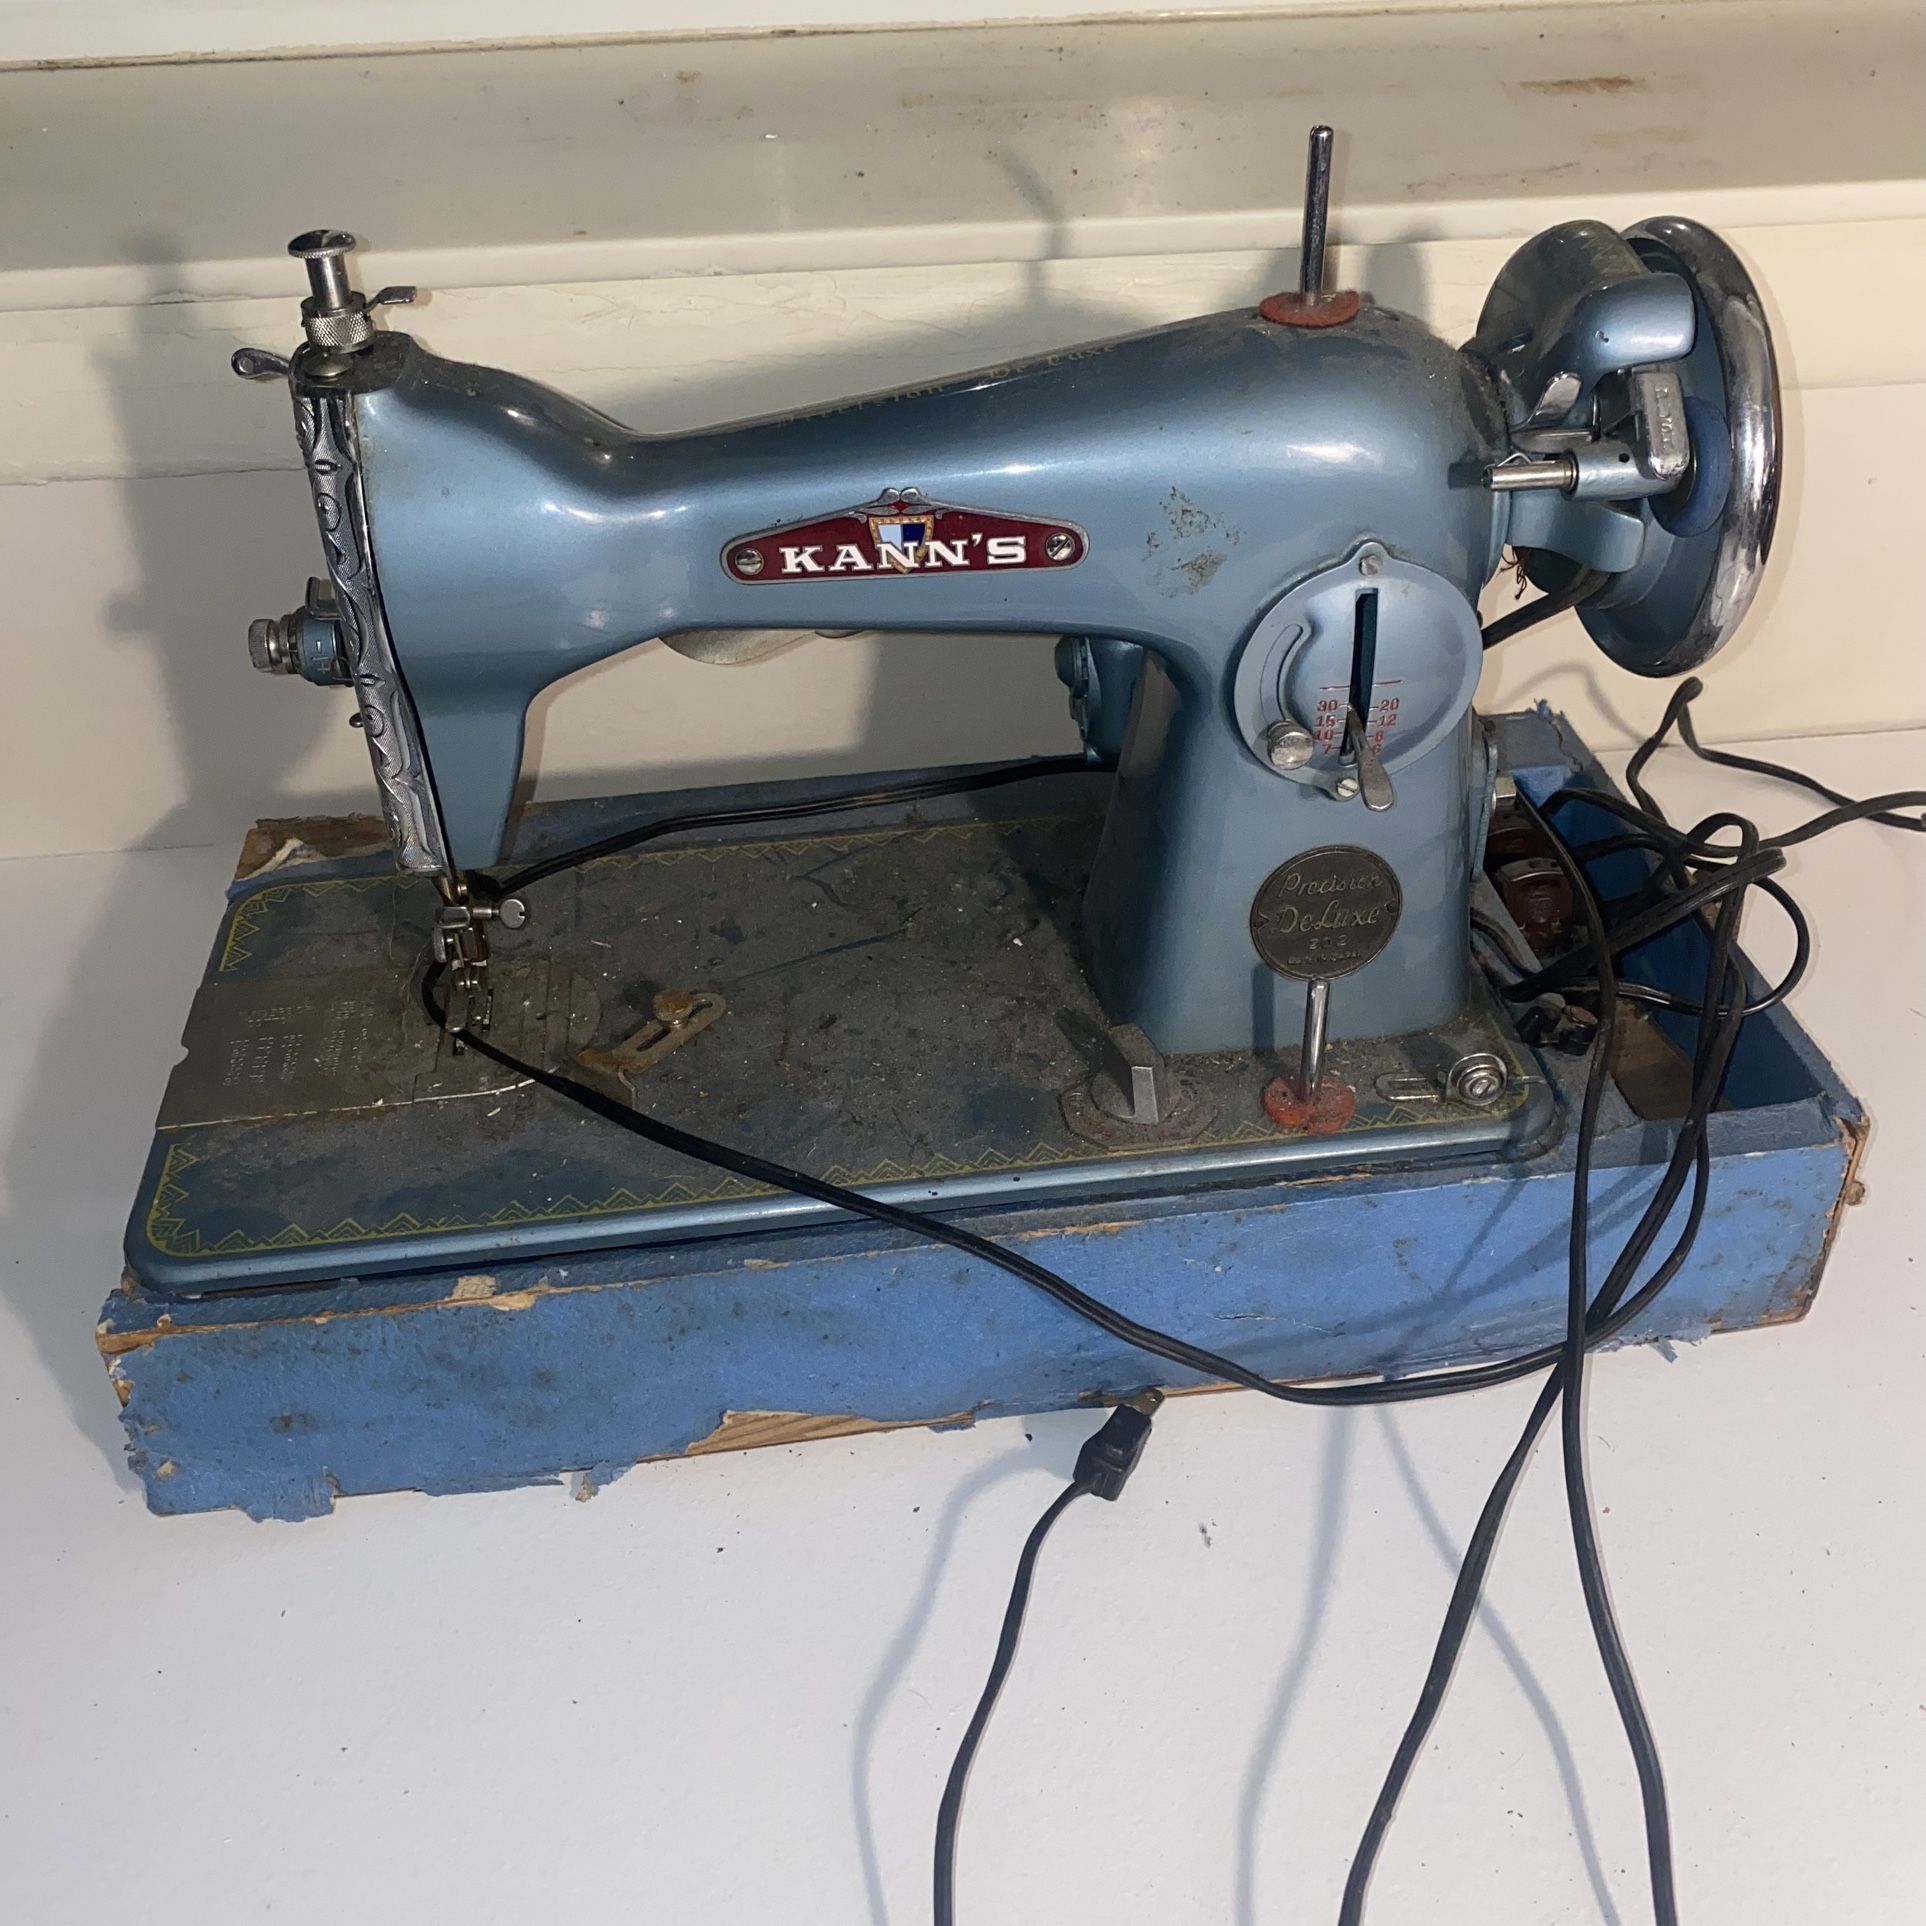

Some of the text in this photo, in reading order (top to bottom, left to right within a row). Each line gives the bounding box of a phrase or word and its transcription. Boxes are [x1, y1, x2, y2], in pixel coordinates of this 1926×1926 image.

[778, 533, 1027, 574] KANN'S
[1316, 699, 1338, 713] 30
[1378, 697, 1399, 712] 20
[1313, 713, 1336, 728] 15
[1376, 713, 1397, 727] 12
[1278, 871, 1384, 898] Precision
